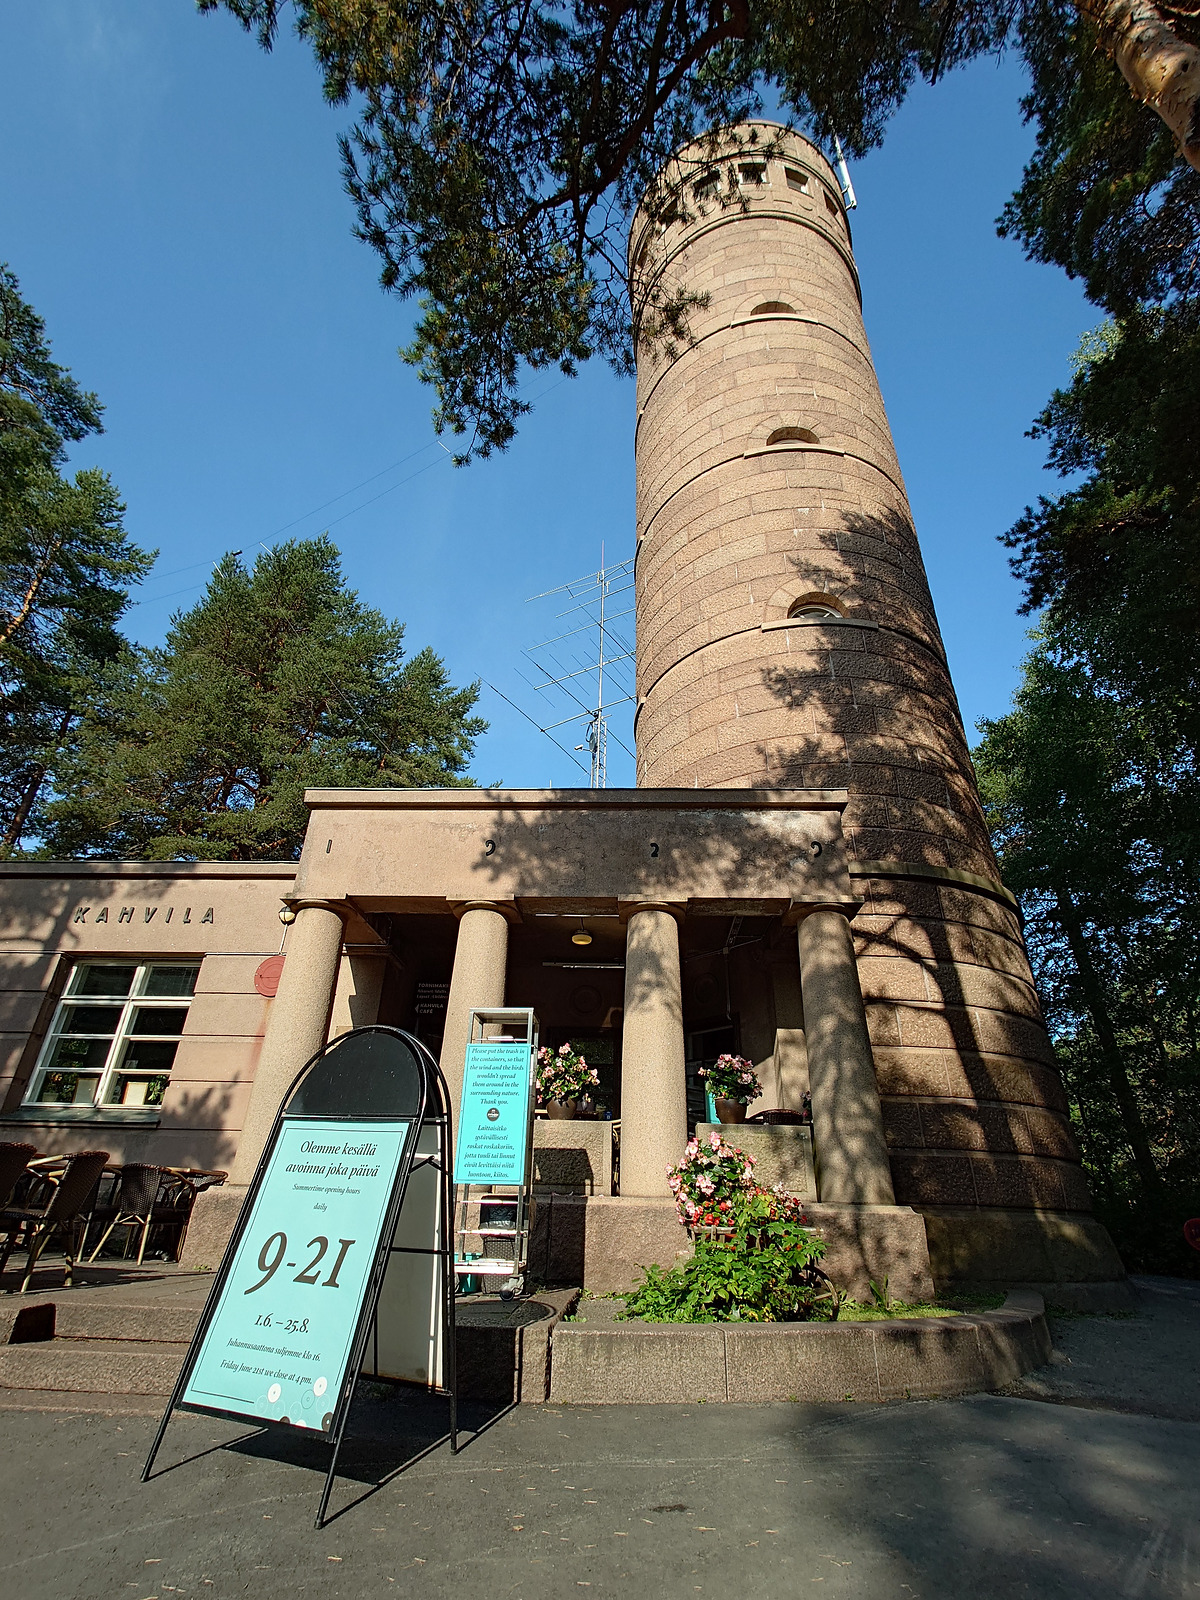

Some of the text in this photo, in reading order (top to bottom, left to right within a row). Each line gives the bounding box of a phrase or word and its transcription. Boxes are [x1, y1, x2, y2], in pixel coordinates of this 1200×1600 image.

[650, 842, 660, 858] 2
[73, 906, 214, 924] KAHVILA
[300, 1140, 378, 1156] Olemme kesällä
[285, 1161, 380, 1180] avoinna joka päivä
[292, 1183, 361, 1196] Summertime opening hours
[313, 1202, 328, 1213] daily
[243, 1231, 356, 1296] 9-21
[254, 1312, 274, 1328] 1.6.
[283, 1317, 310, 1335] 25.8.
[226, 1337, 321, 1362] Juhannusaattona suljemme klo 16.
[219, 1359, 313, 1386] Friday June 21st we close at 4 pm.
